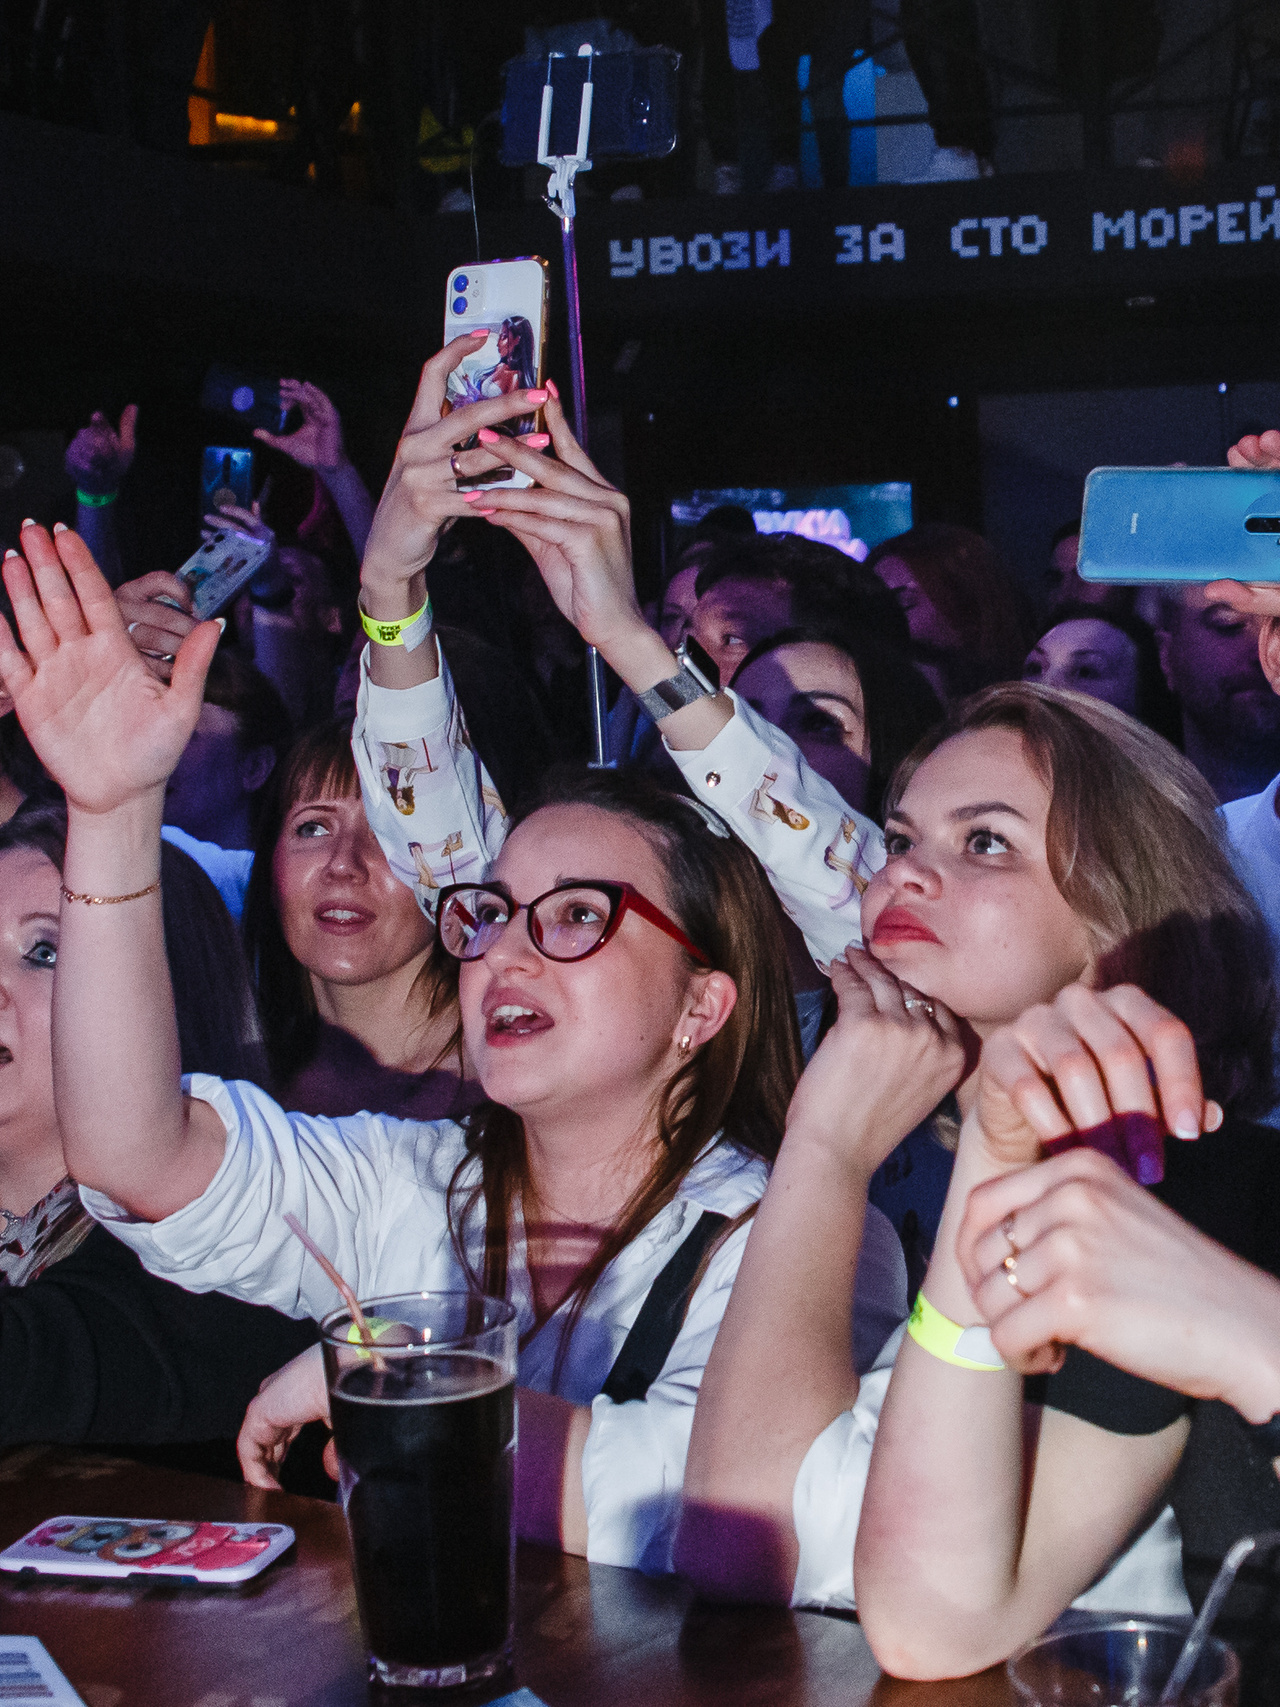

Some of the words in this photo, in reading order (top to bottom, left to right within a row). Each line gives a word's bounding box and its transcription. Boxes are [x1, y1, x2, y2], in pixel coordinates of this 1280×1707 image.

[609, 228, 791, 278] УВОЗИ
[833, 222, 906, 264] ЗА
[951, 215, 1048, 258] СТО
[1092, 185, 1280, 252] МОРЕЙ
